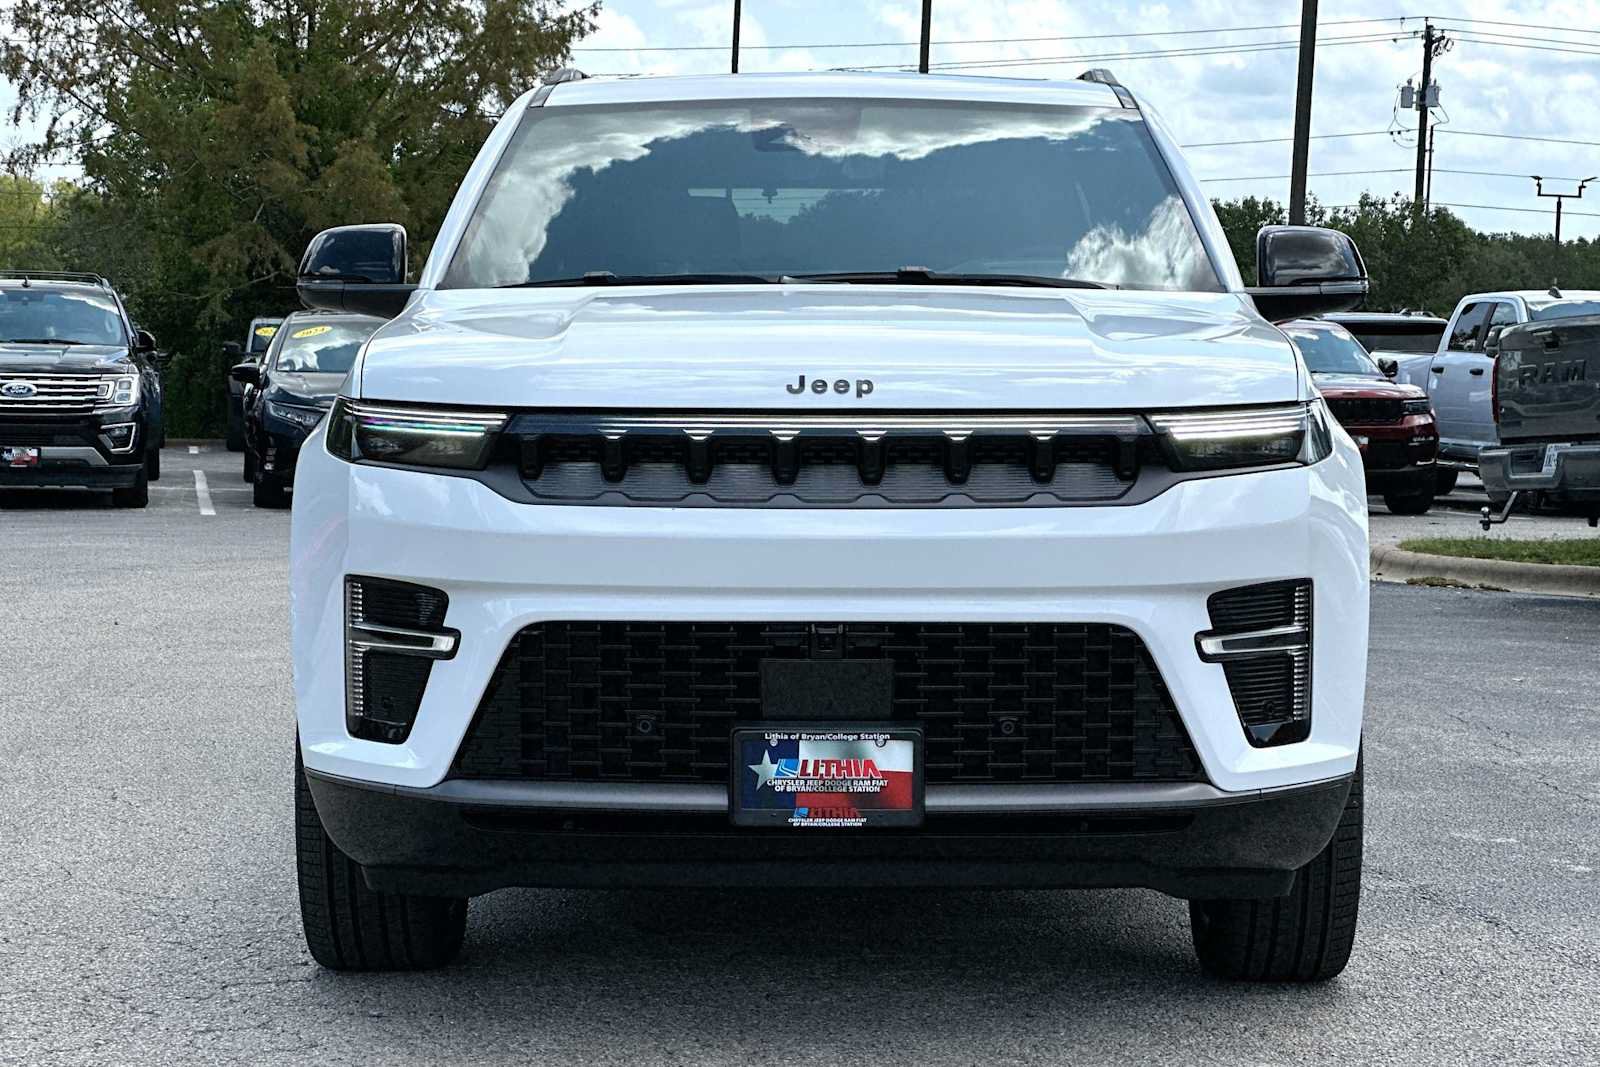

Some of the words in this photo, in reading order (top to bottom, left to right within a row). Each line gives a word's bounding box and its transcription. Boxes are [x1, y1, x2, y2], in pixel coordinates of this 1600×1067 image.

[1519, 360, 1586, 386] RAM
[786, 375, 874, 398] Jeep
[801, 733, 858, 741] Bryan/College
[798, 759, 882, 778] LITHIA
